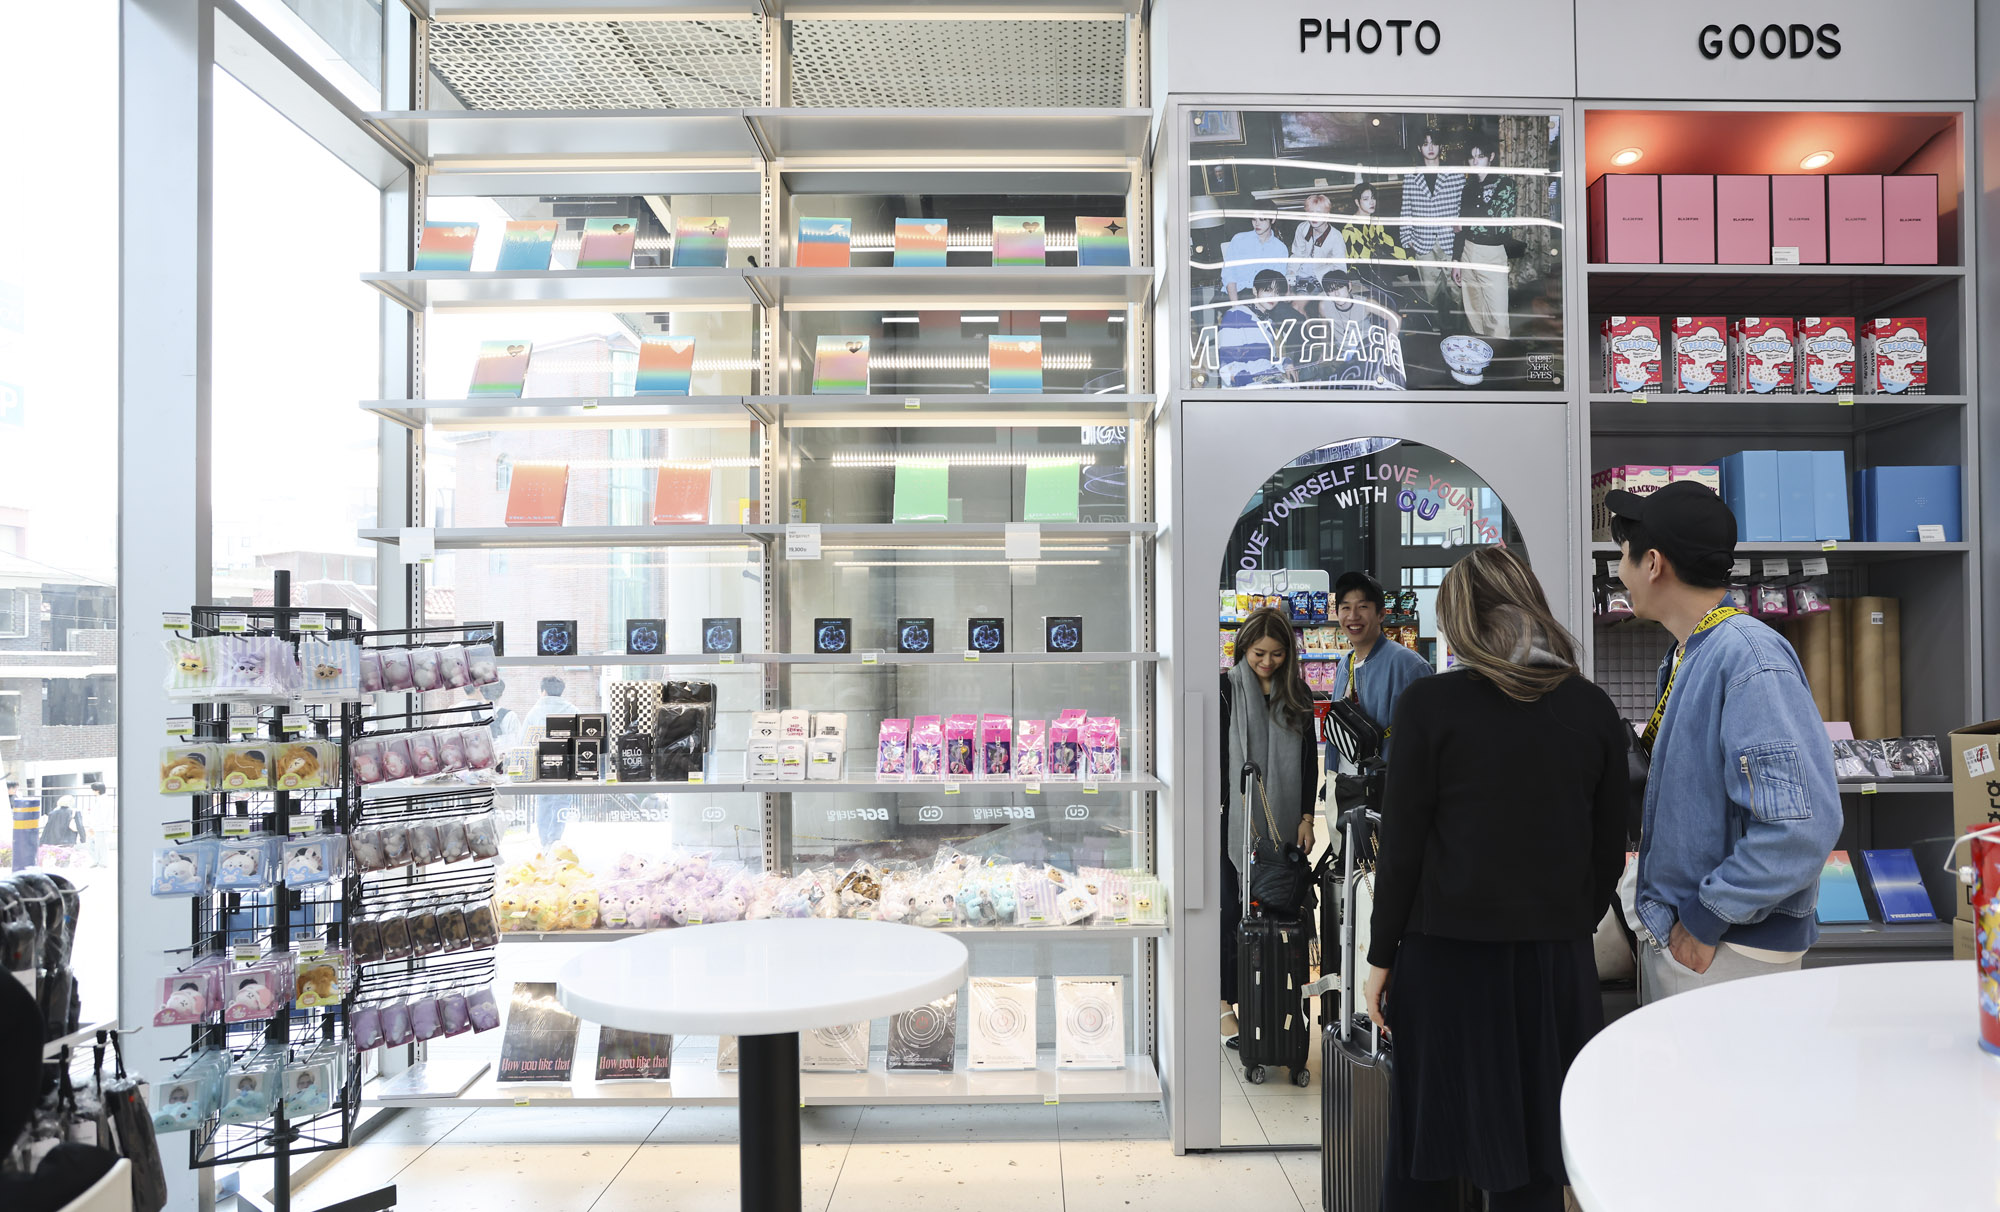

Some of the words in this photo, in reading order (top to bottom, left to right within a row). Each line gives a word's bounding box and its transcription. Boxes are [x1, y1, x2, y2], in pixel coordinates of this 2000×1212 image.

[1299, 17, 1441, 56] PHOTO
[1698, 23, 1842, 59] GOODS
[1617, 340, 1656, 351] TREASURE
[1682, 340, 1724, 351] TREASURE
[1750, 341, 1791, 352] TREASURE
[1811, 340, 1852, 352] TREASURE
[1881, 341, 1924, 352] TREASURE
[1530, 371, 1552, 379] EYES
[1334, 486, 1387, 510] WITH
[1396, 489, 1440, 521] CU
[1236, 530, 1269, 584] LOVE
[1263, 465, 1355, 527] YOURSELF
[1365, 463, 1419, 486] LOVE
[1426, 474, 1475, 517] YOUR
[622, 749, 642, 757] HELLO
[622, 757, 642, 765] TOUR
[501, 1058, 520, 1072] How
[521, 1061, 537, 1073] you
[538, 1058, 553, 1071] like
[554, 1057, 571, 1071] that
[599, 1056, 617, 1069] How
[619, 1060, 636, 1071] you
[652, 1055, 668, 1068] that
